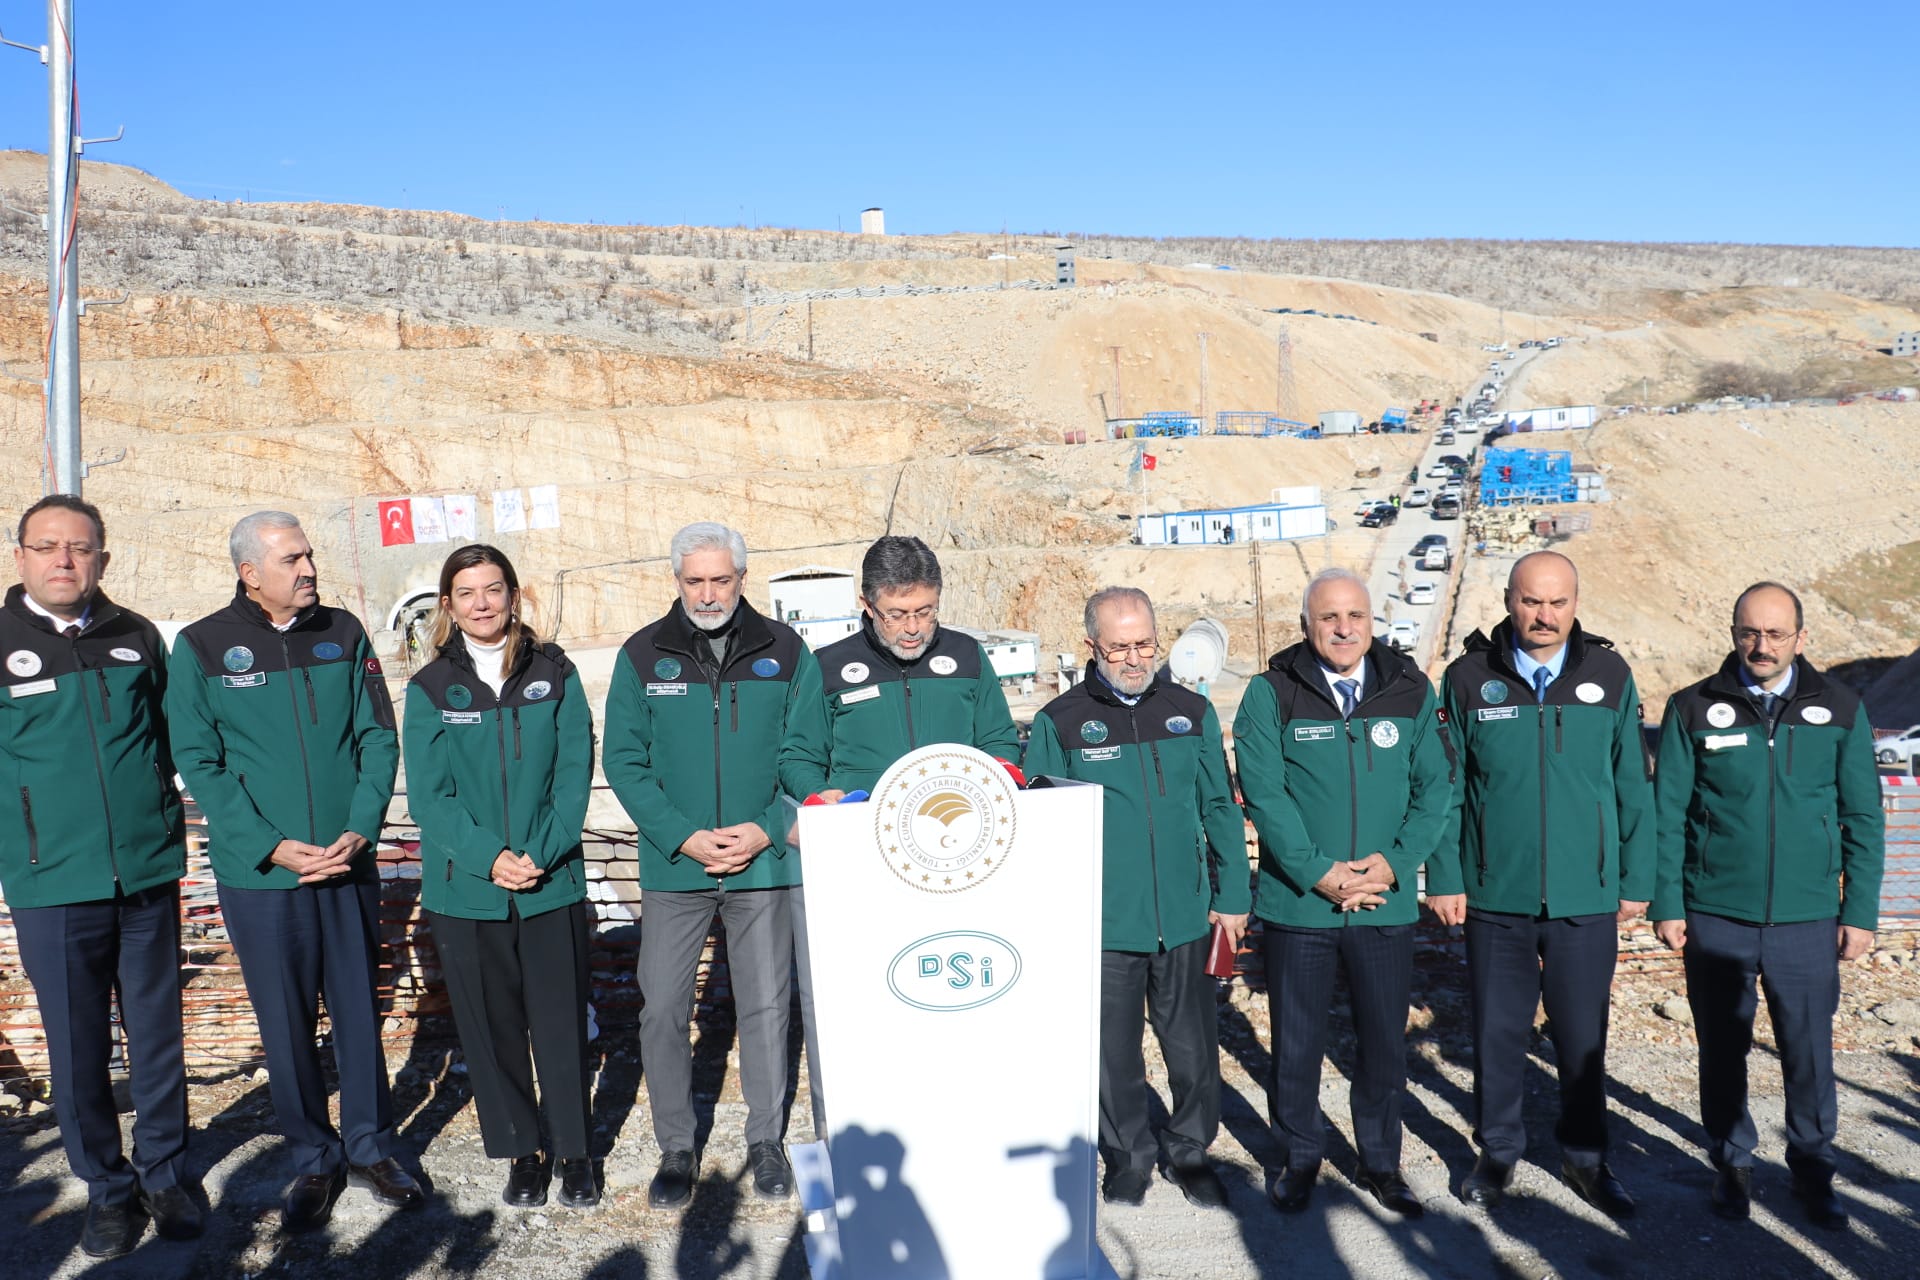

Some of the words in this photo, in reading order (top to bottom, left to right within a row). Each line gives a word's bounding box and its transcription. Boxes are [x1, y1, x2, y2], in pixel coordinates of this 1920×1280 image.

[933, 779, 961, 788] TARIM
[963, 784, 974, 794] VE
[974, 792, 991, 823] ORMAN
